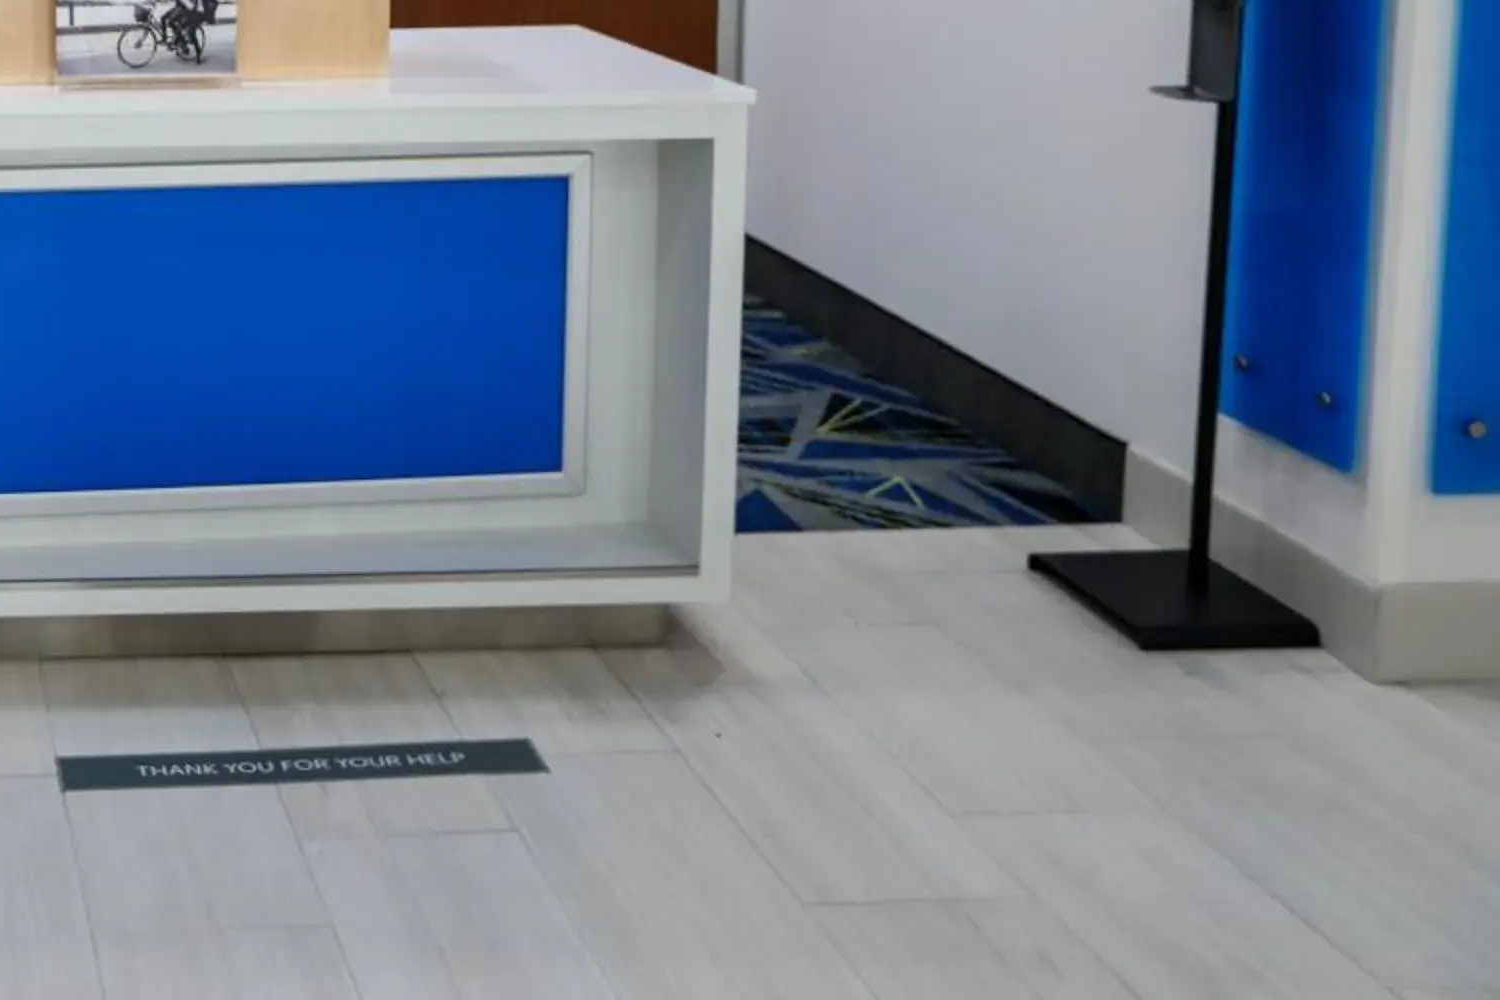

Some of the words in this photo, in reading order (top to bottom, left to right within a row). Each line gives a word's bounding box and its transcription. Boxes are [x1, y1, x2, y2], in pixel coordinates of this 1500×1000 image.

[134, 762, 219, 778] THANK
[223, 760, 274, 774] YOU
[281, 758, 331, 773] FOR
[336, 754, 402, 770] YOUR
[405, 751, 466, 766] HELP
